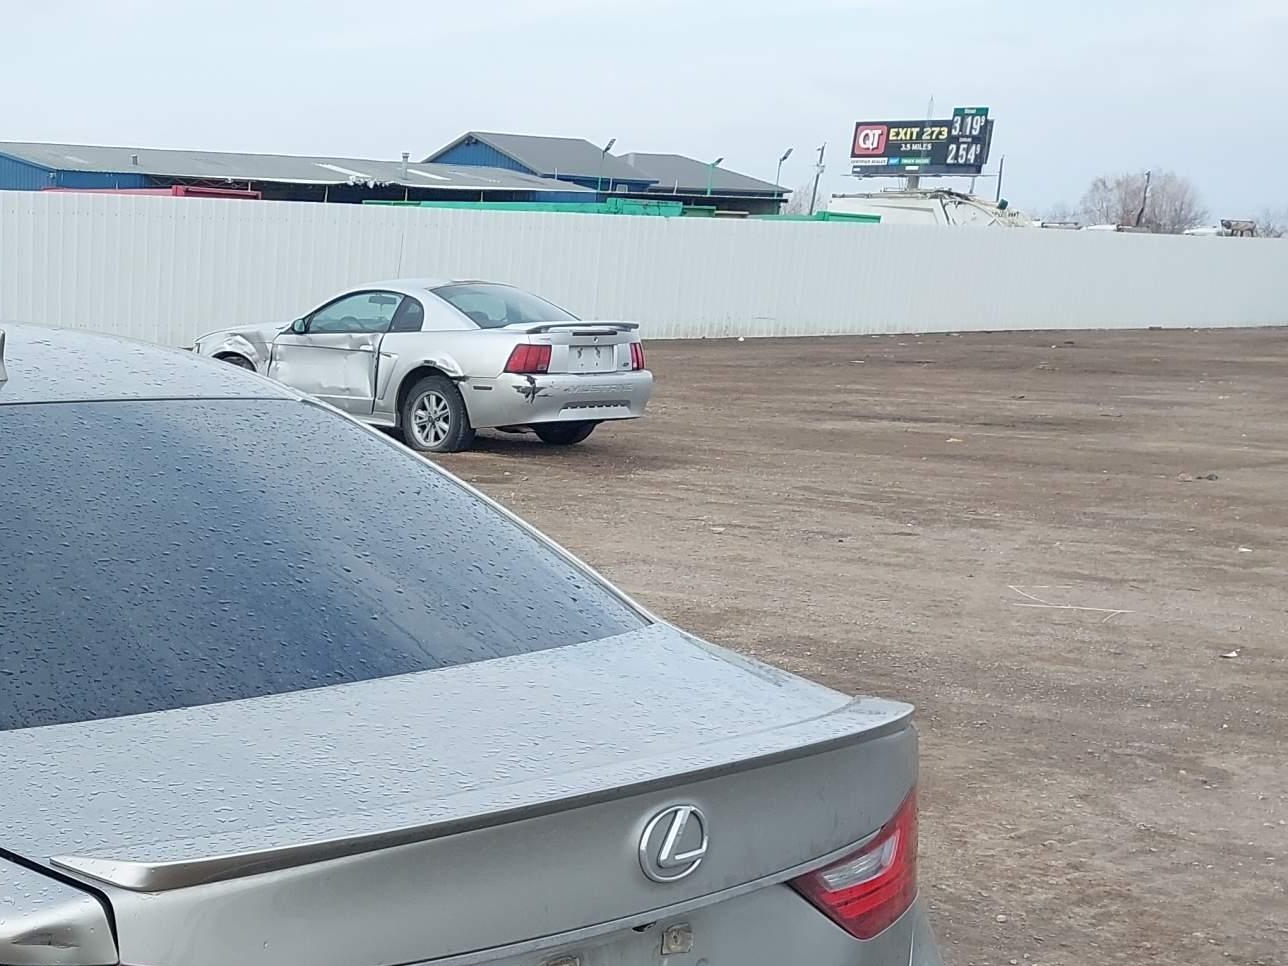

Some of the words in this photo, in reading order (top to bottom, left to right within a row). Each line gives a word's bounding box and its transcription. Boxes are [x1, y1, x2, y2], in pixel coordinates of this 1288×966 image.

[858, 129, 882, 151] QT
[889, 127, 919, 141] EXIT
[922, 126, 949, 140] 273
[911, 143, 932, 151] MILES
